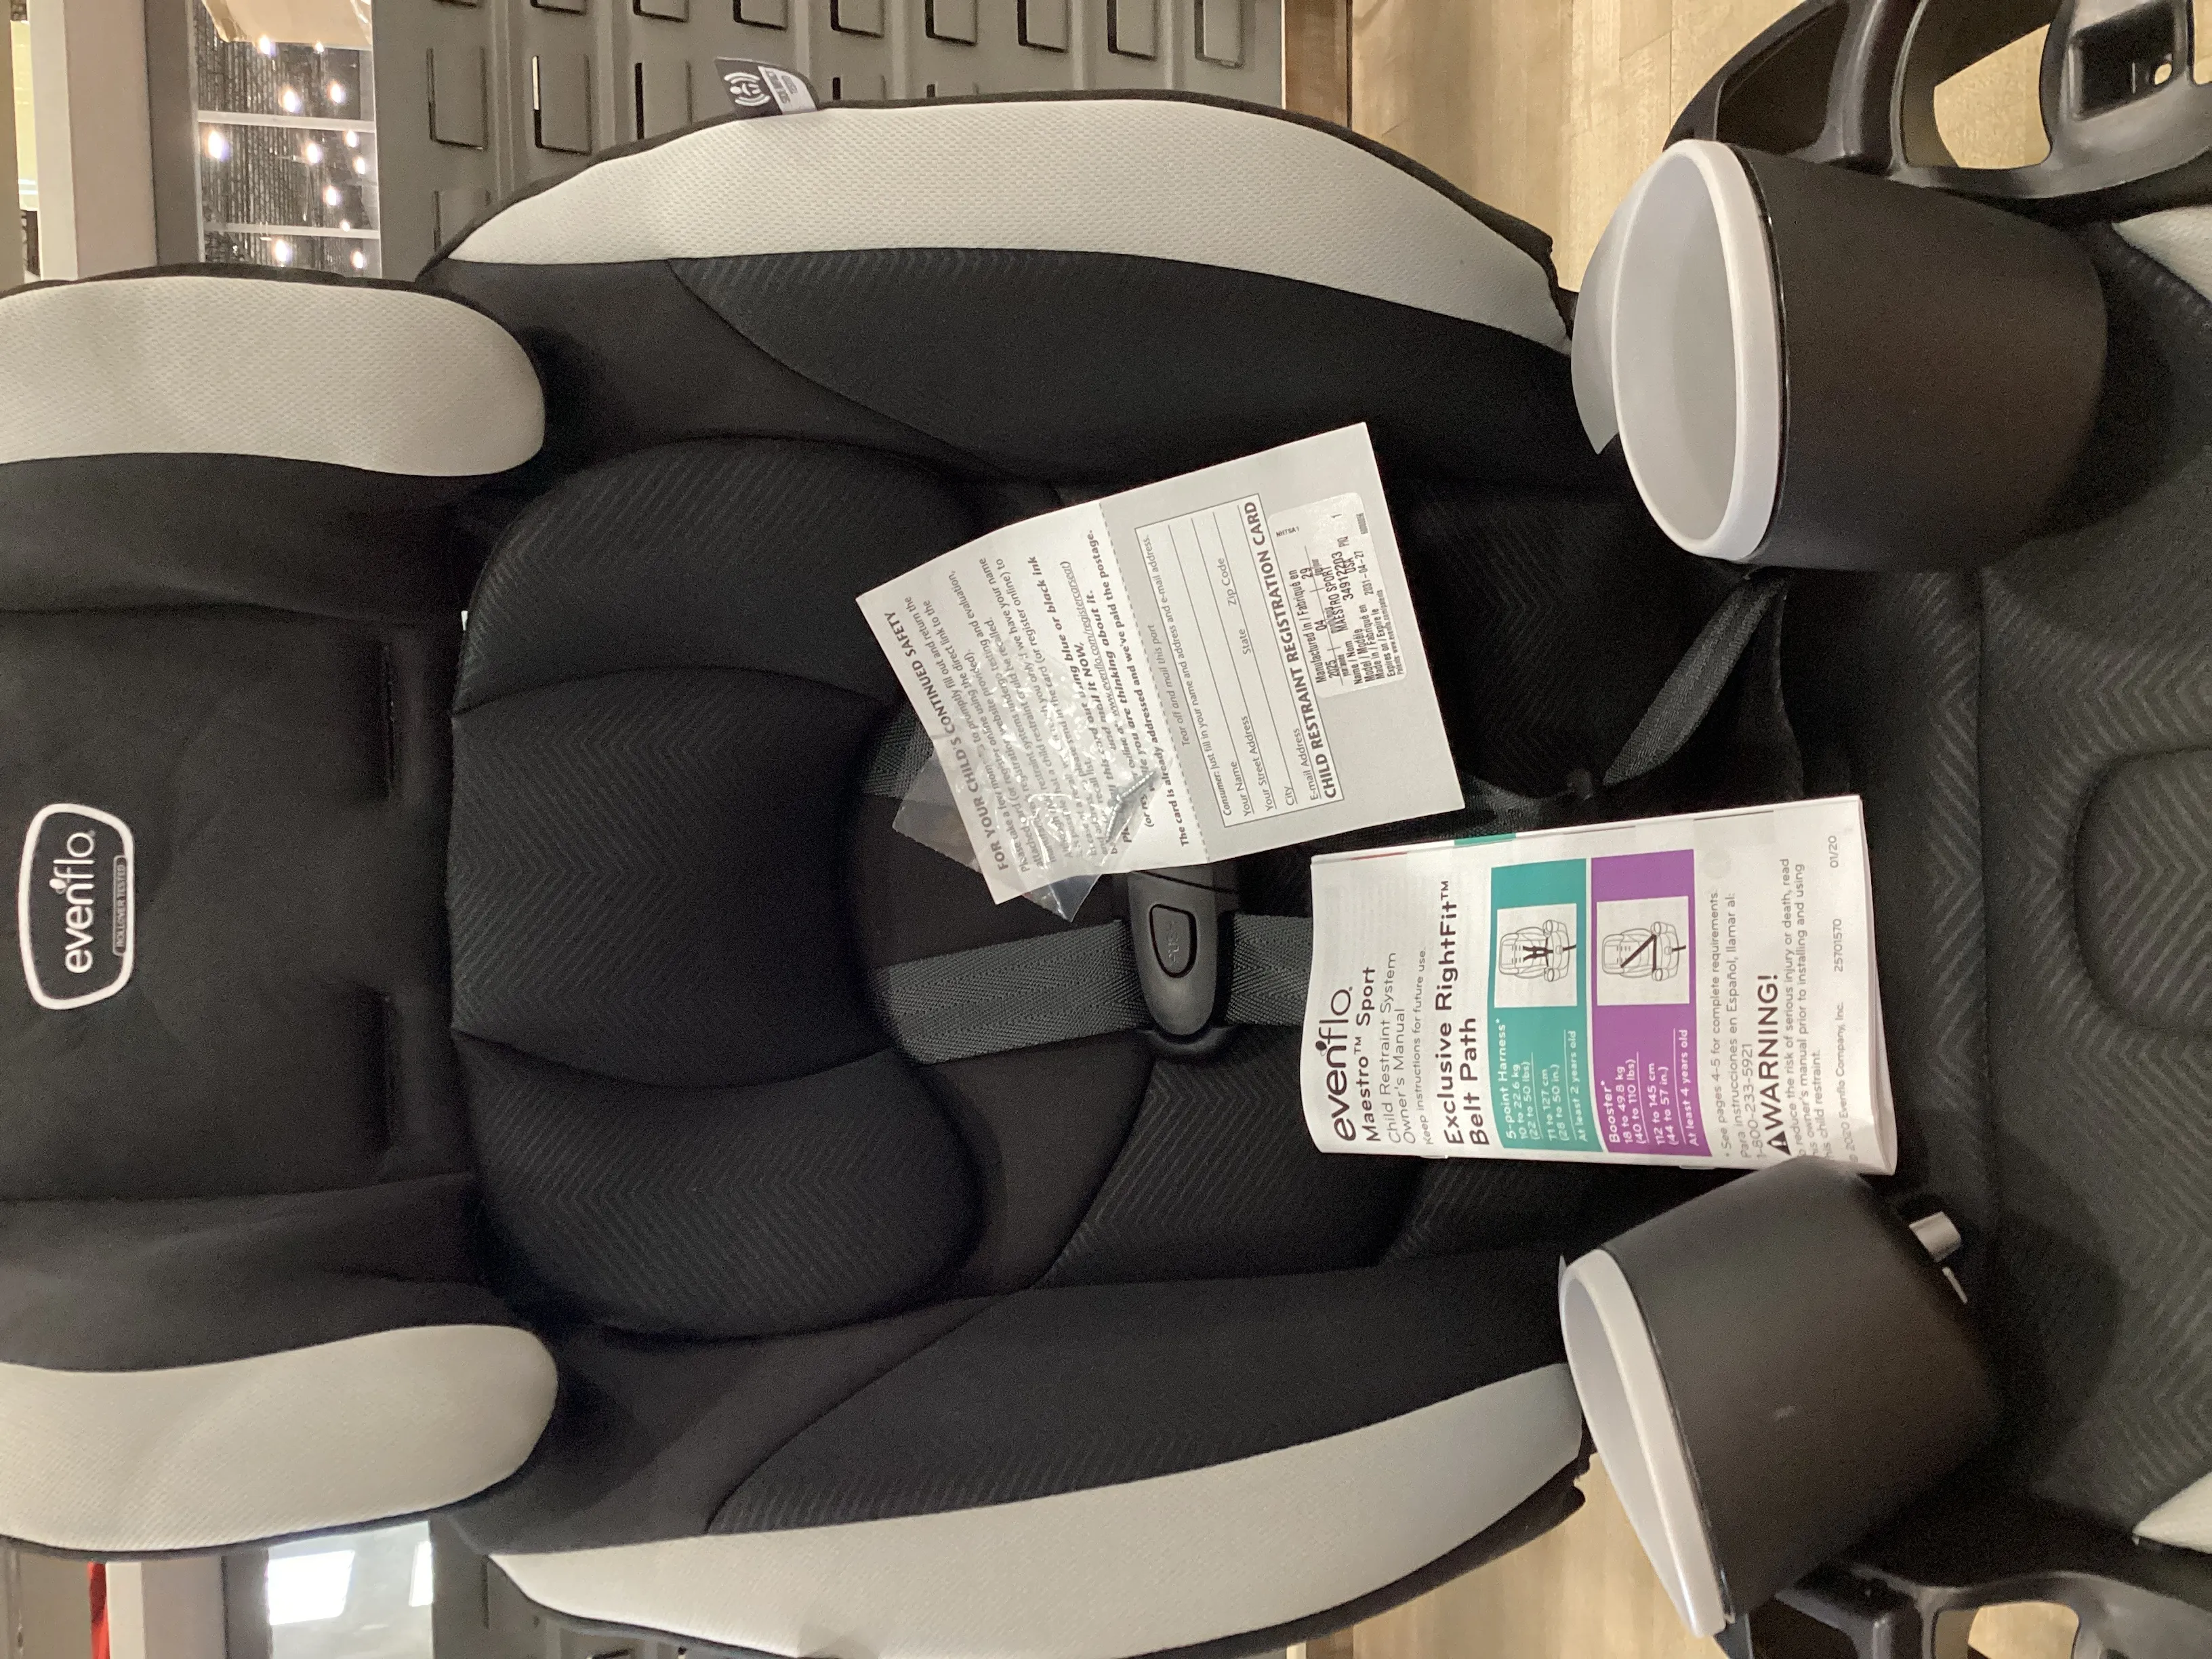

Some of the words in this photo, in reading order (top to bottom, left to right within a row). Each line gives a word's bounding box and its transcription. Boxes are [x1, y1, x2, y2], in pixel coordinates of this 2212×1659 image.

[1242, 500, 1265, 546] CARD
[1084, 528, 1109, 579] postage.
[1140, 535, 1159, 573] address.
[1342, 557, 1356, 573] USA
[978, 556, 996, 585] name
[1215, 557, 1231, 586] Code
[1319, 565, 1337, 592] SPORT
[1330, 550, 1354, 600] 34912203
[947, 571, 975, 618] evaluation,
[992, 585, 1009, 608] your
[1000, 571, 1021, 607] online)
[1036, 578, 1057, 614] black
[1152, 574, 1168, 604] e-mail
[1288, 580, 1311, 615] Fabriqué
[1002, 609, 1017, 633] have
[1107, 602, 1125, 629] paid
[1257, 550, 1298, 663] REGISTRATION
[1326, 592, 1348, 632] MAESTRO
[884, 609, 916, 657] SAFETY
[912, 612, 931, 640] return
[1017, 607, 1038, 645] register
[1089, 606, 1109, 647] about
[1146, 623, 1161, 646] part
[1359, 613, 1378, 645] Fabriqué
[1057, 633, 1073, 662] blue
[1116, 630, 1132, 663] we've
[1153, 646, 1166, 665] this
[1167, 624, 1185, 659] address
[1235, 628, 1252, 655] State
[945, 644, 964, 671] direct
[1073, 640, 1093, 678] NOW,
[1303, 632, 1327, 683] Manufactured
[1324, 659, 1340, 678] 2025
[1360, 659, 1375, 682] Model
[1372, 659, 1385, 679] Made
[1382, 652, 1396, 676] Expires
[1103, 649, 1130, 705] thinking
[1158, 665, 1172, 689] mail
[1349, 663, 1363, 684] Name
[911, 659, 956, 734] CONTINUED
[1185, 680, 1199, 706] name
[1290, 665, 1323, 750] RESTRAINT
[1134, 688, 1158, 744] addressed
[1193, 706, 1208, 729] your
[1177, 724, 1191, 746] Tear
[1202, 740, 1212, 752] fill
[1238, 715, 1258, 756] Address
[1290, 727, 1311, 768] Address
[949, 737, 979, 792] CHILD'S
[1152, 745, 1173, 787] already
[1206, 752, 1220, 770] Just
[1250, 756, 1267, 786] Street
[1314, 752, 1337, 799] CHILD
[1228, 760, 1245, 792] Name
[1302, 769, 1319, 800] E-mail
[1211, 770, 1233, 817] Consumer:
[1238, 792, 1252, 816] Your
[1261, 787, 1275, 811] Your
[1281, 784, 1296, 806] City
[972, 796, 996, 838] YOUR
[1168, 798, 1183, 825] card
[989, 840, 1008, 870] FOR
[1828, 835, 1839, 867] 01/20
[1780, 858, 1790, 884] read
[1794, 863, 1805, 897] using
[52, 832, 95, 973] evenflo
[1782, 889, 1792, 927] death,
[1795, 902, 1804, 924] and
[1710, 889, 1721, 972] requirements.
[1725, 912, 1736, 951] llamar
[1784, 932, 1791, 944] or
[1832, 918, 1843, 972] 25701570
[1784, 949, 1795, 982] injury
[1795, 929, 1807, 984] installing
[1356, 966, 1375, 1025] Sport
[1380, 952, 1396, 1012] System
[1413, 977, 1424, 1012] future
[1725, 957, 1739, 1011] Español,
[1710, 977, 1721, 1033] complete
[1785, 987, 1793, 1030] serious
[1797, 1005, 1808, 1033] prior
[1393, 1008, 1404, 1069] Manual
[1412, 1016, 1421, 1033] for
[1568, 1030, 1576, 1048] old
[1679, 1029, 1687, 1047] old
[1729, 1017, 1737, 1033] en
[1459, 1018, 1477, 1080] Path
[1711, 1038, 1719, 1053] for
[1757, 975, 1783, 1130] WARNING!
[1784, 1035, 1793, 1048] of
[1317, 988, 1356, 1141] evenflo
[1379, 1019, 1391, 1094] Restraint
[1511, 1063, 1520, 1076] kg
[1521, 1061, 1530, 1081] lbs)
[1569, 1052, 1580, 1082] years
[1625, 1059, 1635, 1080] lbs)
[1680, 1052, 1690, 1083] years
[1711, 1059, 1721, 1081] 4-5
[1784, 1052, 1794, 1073] risk
[1797, 1038, 1807, 1085] manual
[1412, 1038, 1424, 1109] instructions
[1435, 1022, 1464, 1144] Exclusive
[1542, 1069, 1549, 1086] cm
[1616, 1066, 1624, 1079] kg
[1648, 1063, 1655, 1080] cm
[1729, 1038, 1742, 1126] instrucciones
[1811, 1048, 1822, 1103] restraint.
[1512, 1081, 1522, 1108] 22.6
[1523, 1086, 1532, 1101] 50
[1541, 1089, 1551, 1110] 127
[1552, 1086, 1561, 1102] 50
[1616, 1084, 1625, 1111] 49.8
[1627, 1084, 1637, 1103] 110
[1647, 1085, 1658, 1107] 145
[1660, 1089, 1669, 1105] 57
[1742, 1043, 1766, 1158] 1-800-233-5921
[1785, 1078, 1795, 1098] the
[1394, 1078, 1416, 1143] Owner's
[1462, 1092, 1490, 1145] Belt
[1499, 1086, 1516, 1139] 5-point
[1517, 1111, 1524, 1122] to
[1527, 1105, 1534, 1116] to
[1546, 1113, 1553, 1124] to
[1555, 1106, 1562, 1117] to
[1572, 1098, 1583, 1125] least
[1631, 1107, 1639, 1119] to
[1652, 1111, 1660, 1122] to
[1664, 1109, 1671, 1121] to
[1682, 1100, 1694, 1128] least
[1714, 1086, 1727, 1122] pages
[1799, 1090, 1814, 1138] owner's
[1382, 1102, 1401, 1143] Child
[1419, 1115, 1433, 1145] Keep
[1519, 1127, 1528, 1139] 10
[1578, 1129, 1588, 1141] At
[1621, 1115, 1629, 1127] to
[1633, 1124, 1646, 1143] (40
[1654, 1127, 1665, 1144] 112
[1665, 1125, 1679, 1145] (44
[1788, 1103, 1803, 1144] reduce
[1814, 1109, 1828, 1138] child
[1623, 1131, 1633, 1143] 18
[1688, 1132, 1699, 1145] At
[1738, 1131, 1751, 1158] Para
